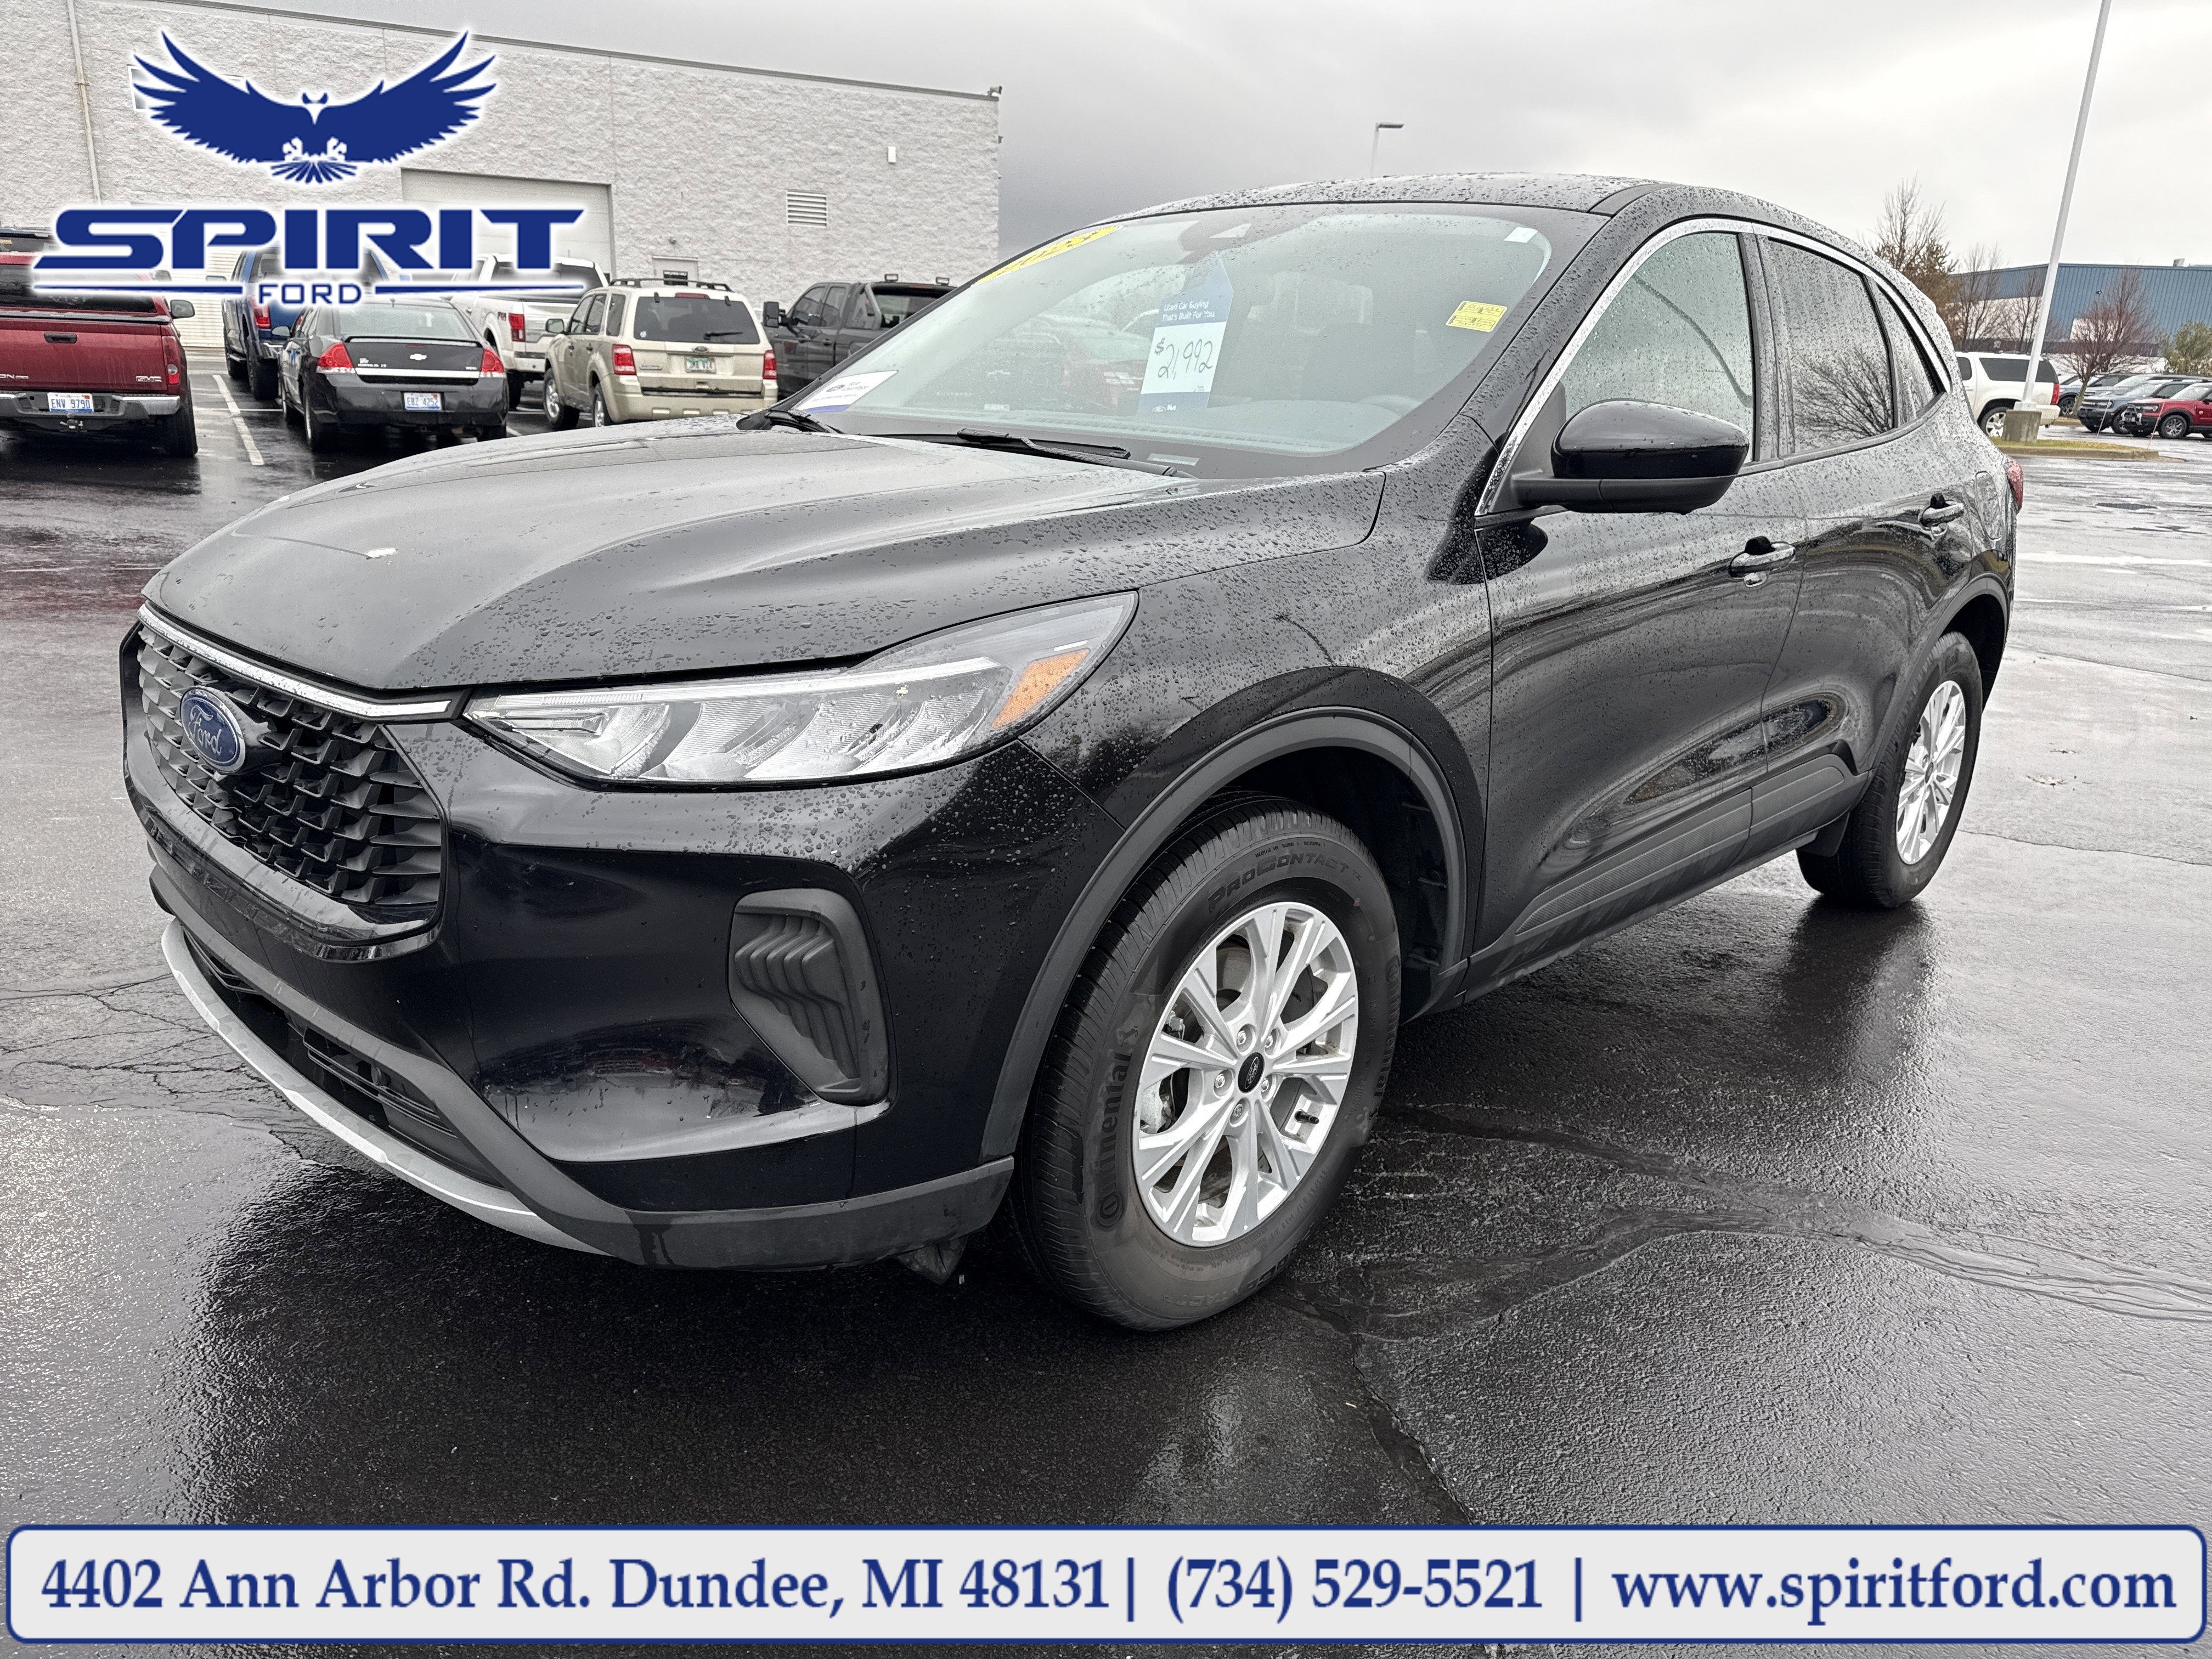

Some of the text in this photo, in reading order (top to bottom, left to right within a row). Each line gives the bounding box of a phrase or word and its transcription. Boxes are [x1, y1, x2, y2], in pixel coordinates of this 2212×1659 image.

[1164, 302, 1178, 312] Used
[1189, 300, 1209, 310] Buying
[1162, 313, 1178, 321] That's
[1178, 311, 1192, 320] Built
[1193, 310, 1202, 319] For
[50, 398, 91, 409] ENV 9790
[188, 704, 222, 756] Ford
[1246, 1062, 1258, 1085] Ford
